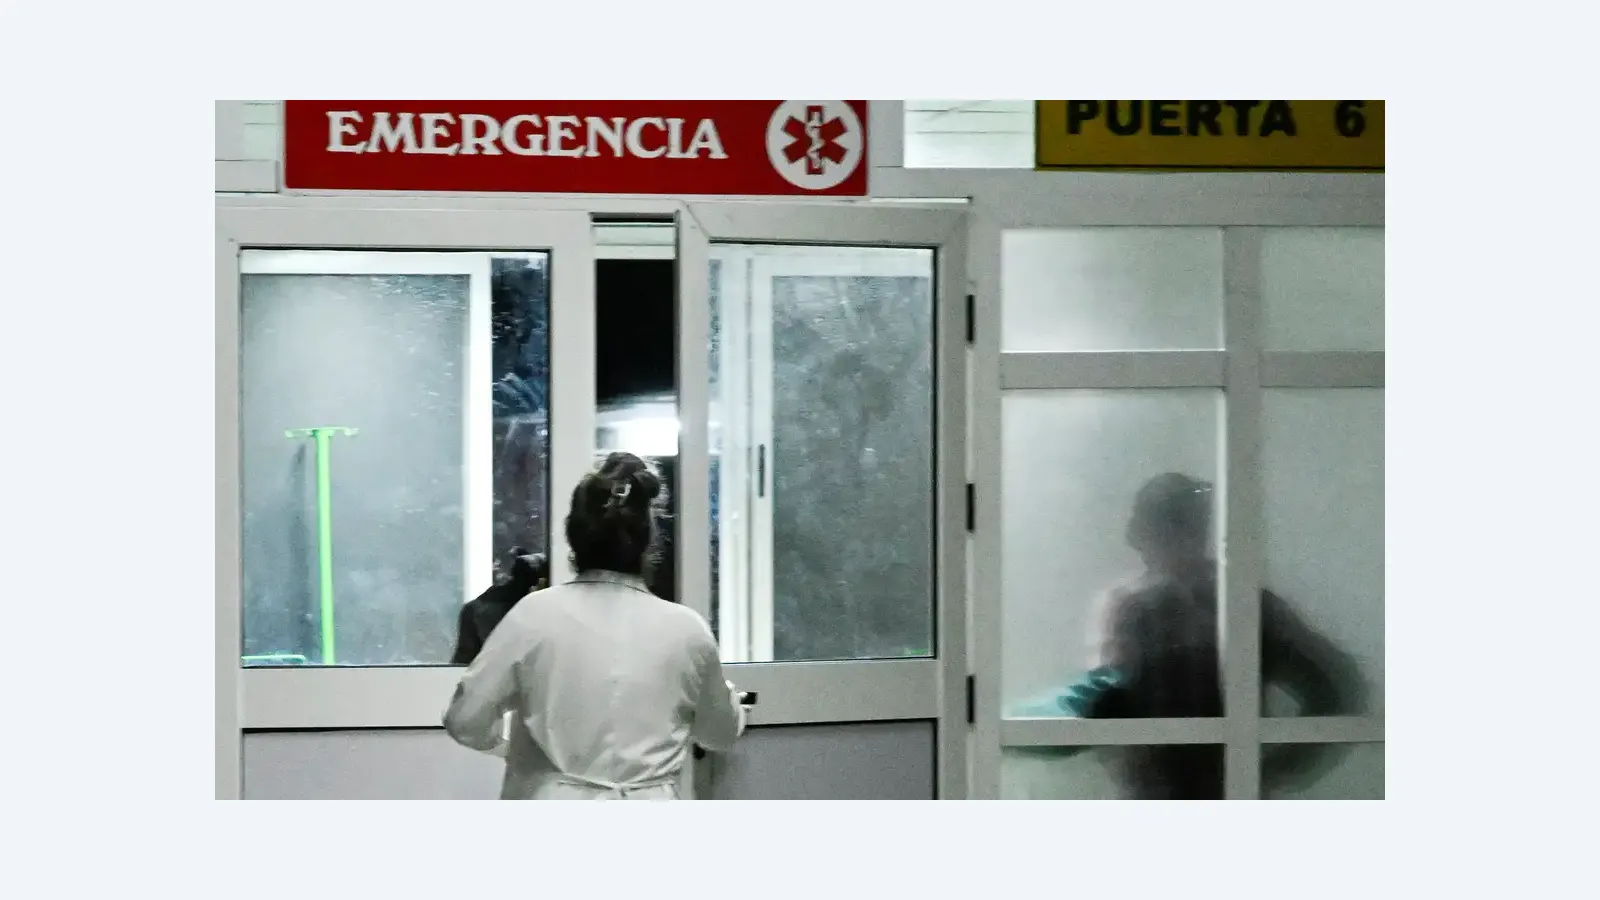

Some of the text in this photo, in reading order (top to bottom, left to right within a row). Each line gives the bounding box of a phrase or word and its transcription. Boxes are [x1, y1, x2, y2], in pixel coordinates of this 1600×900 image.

[326, 110, 728, 160] EMERGENCIA
[1065, 100, 1366, 138] PUERTA 6
